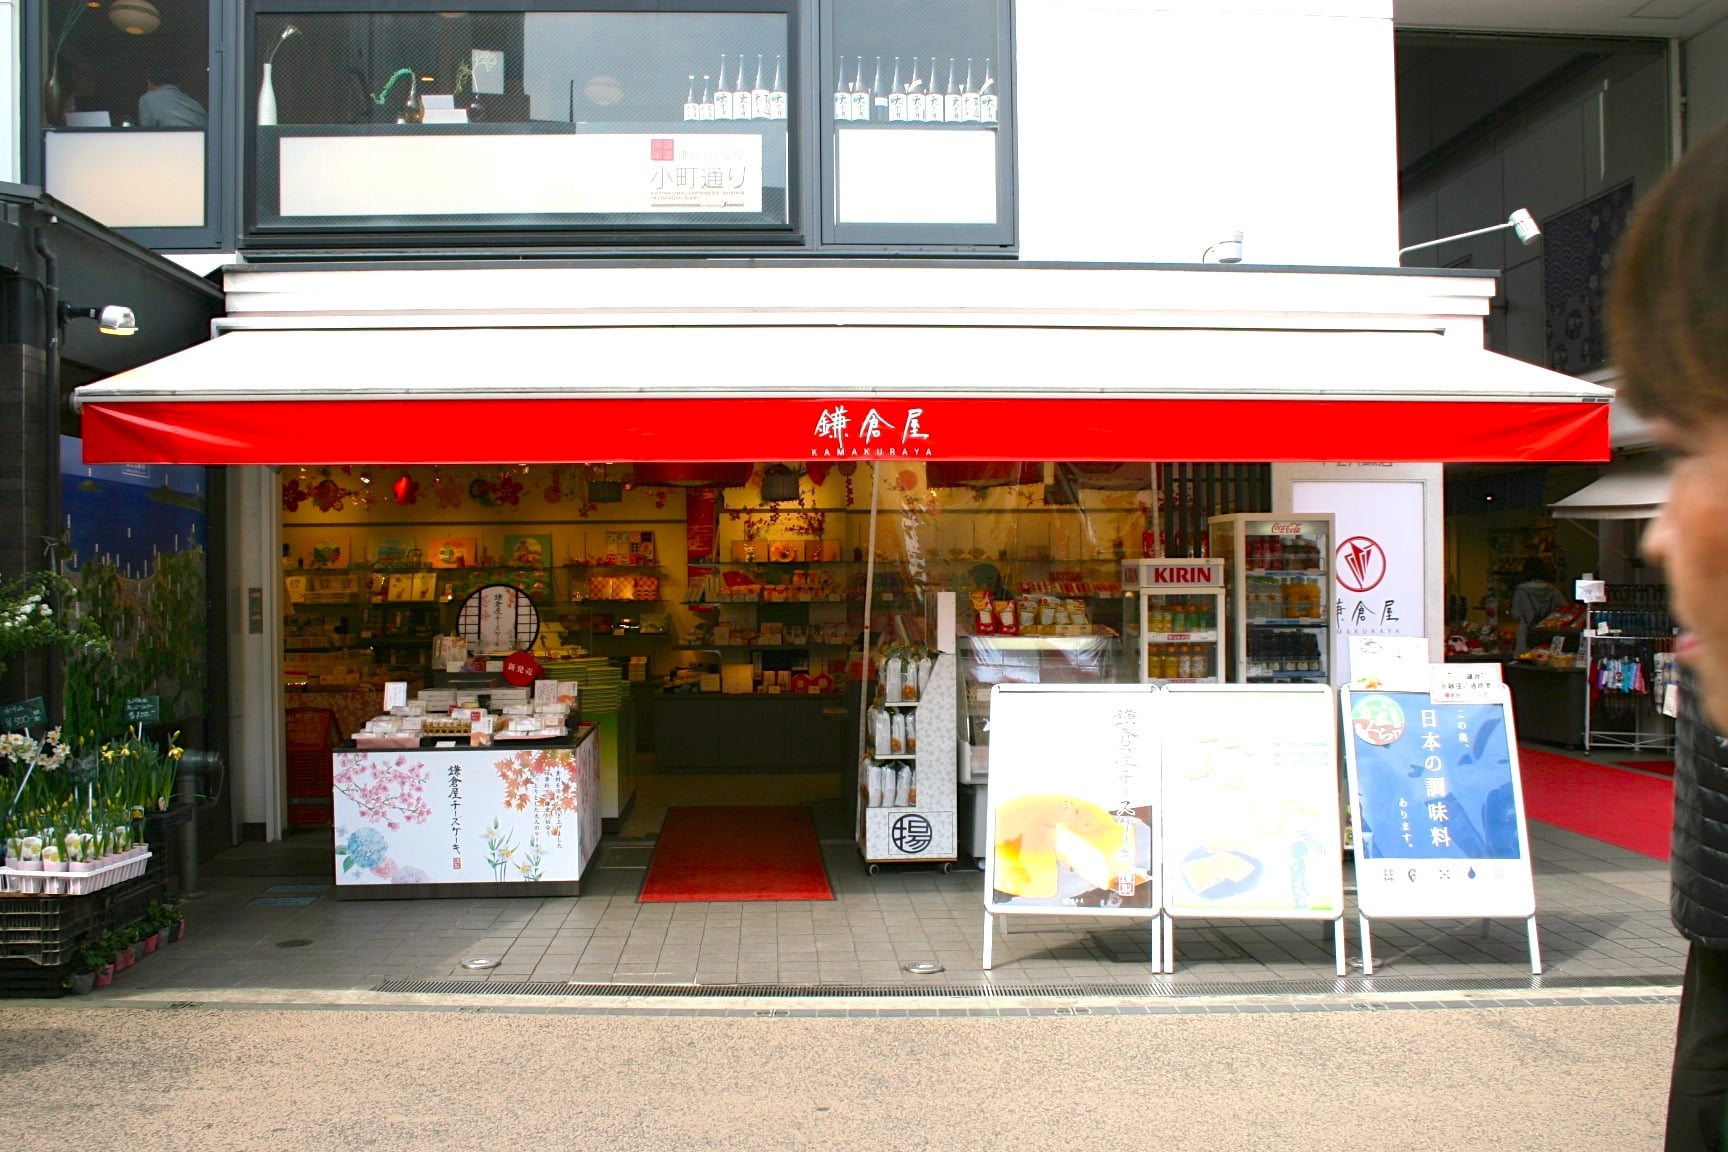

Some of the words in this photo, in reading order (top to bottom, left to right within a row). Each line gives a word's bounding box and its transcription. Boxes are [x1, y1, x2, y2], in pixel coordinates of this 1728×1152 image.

[650, 165, 746, 190] 小町通り
[813, 404, 930, 448] 鎌倉屋
[811, 448, 933, 457] KAMAKURAYA
[1154, 567, 1212, 583] KIRIN
[507, 662, 534, 677] 新発売
[1420, 708, 1452, 848] 日本の調味料
[1398, 797, 1413, 848] あります。
